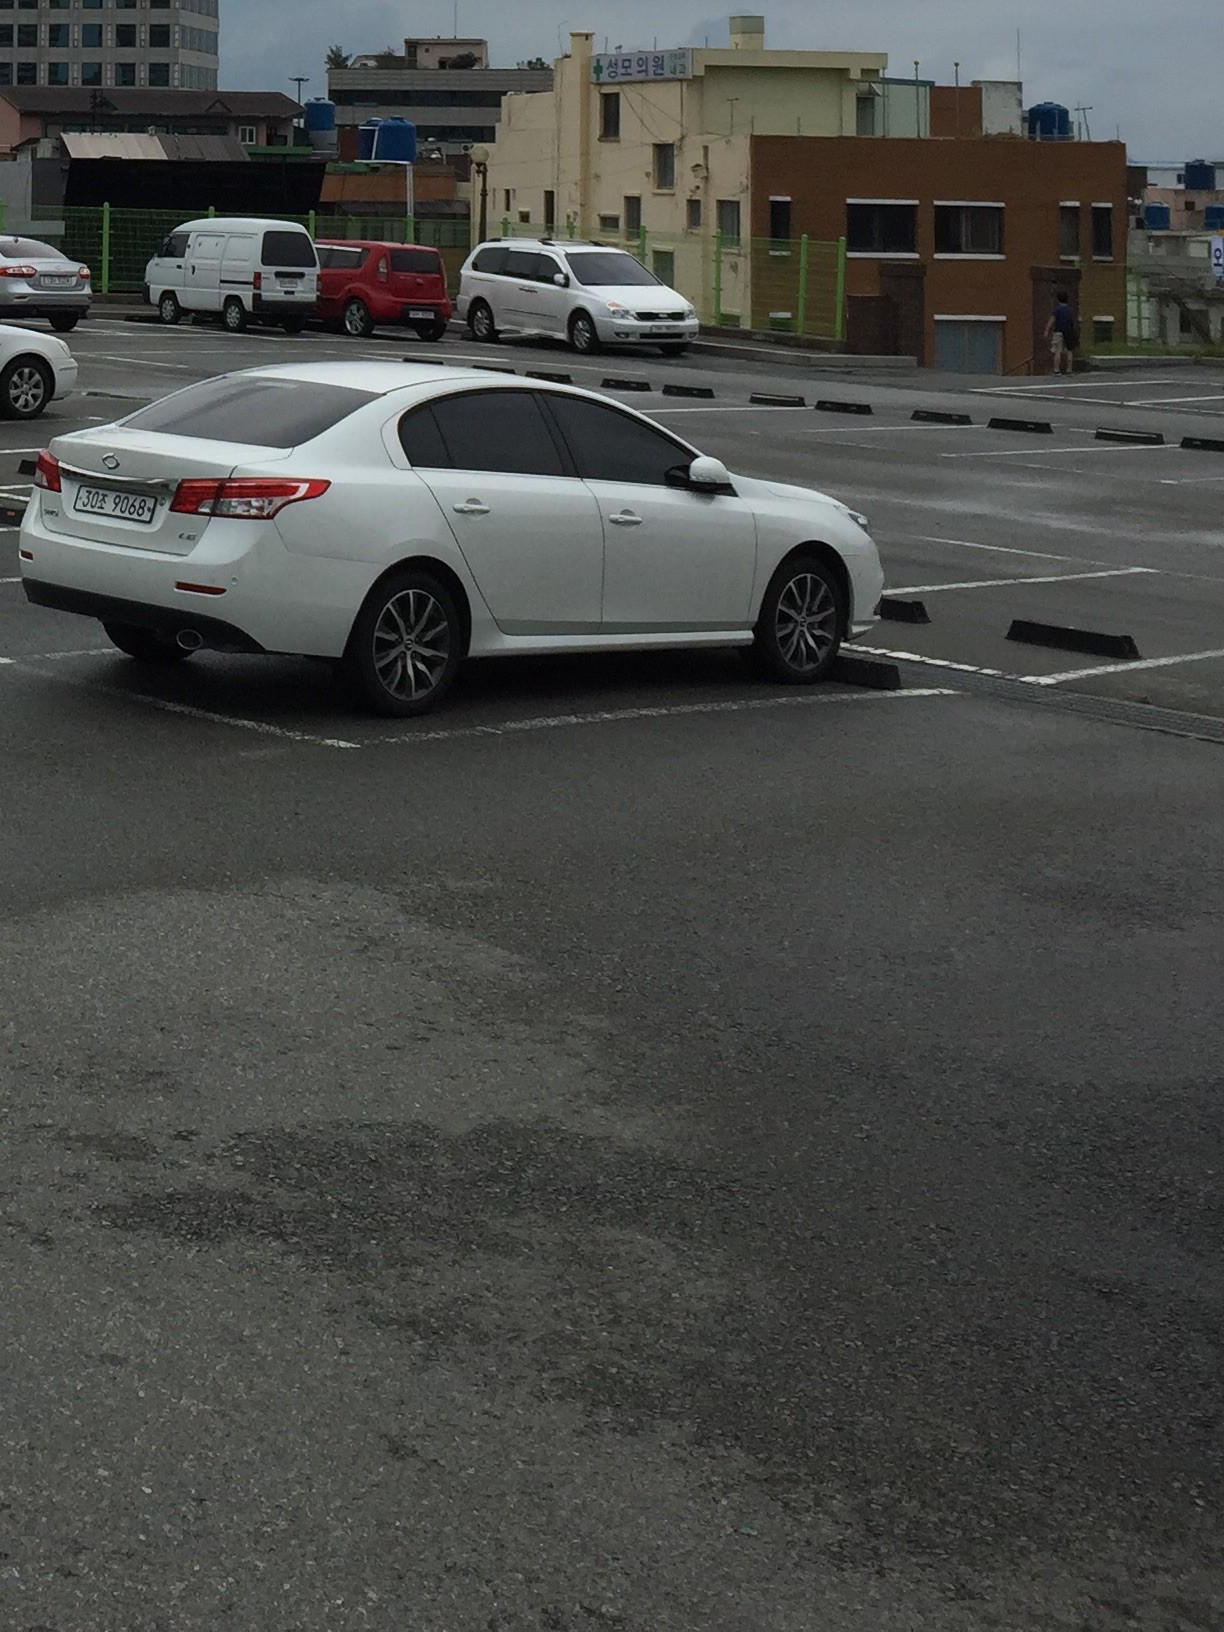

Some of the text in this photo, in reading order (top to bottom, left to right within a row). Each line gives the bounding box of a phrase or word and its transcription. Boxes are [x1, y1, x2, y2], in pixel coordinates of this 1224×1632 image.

[606, 54, 665, 79] 성모의원
[82, 489, 147, 517] 30조 9068
